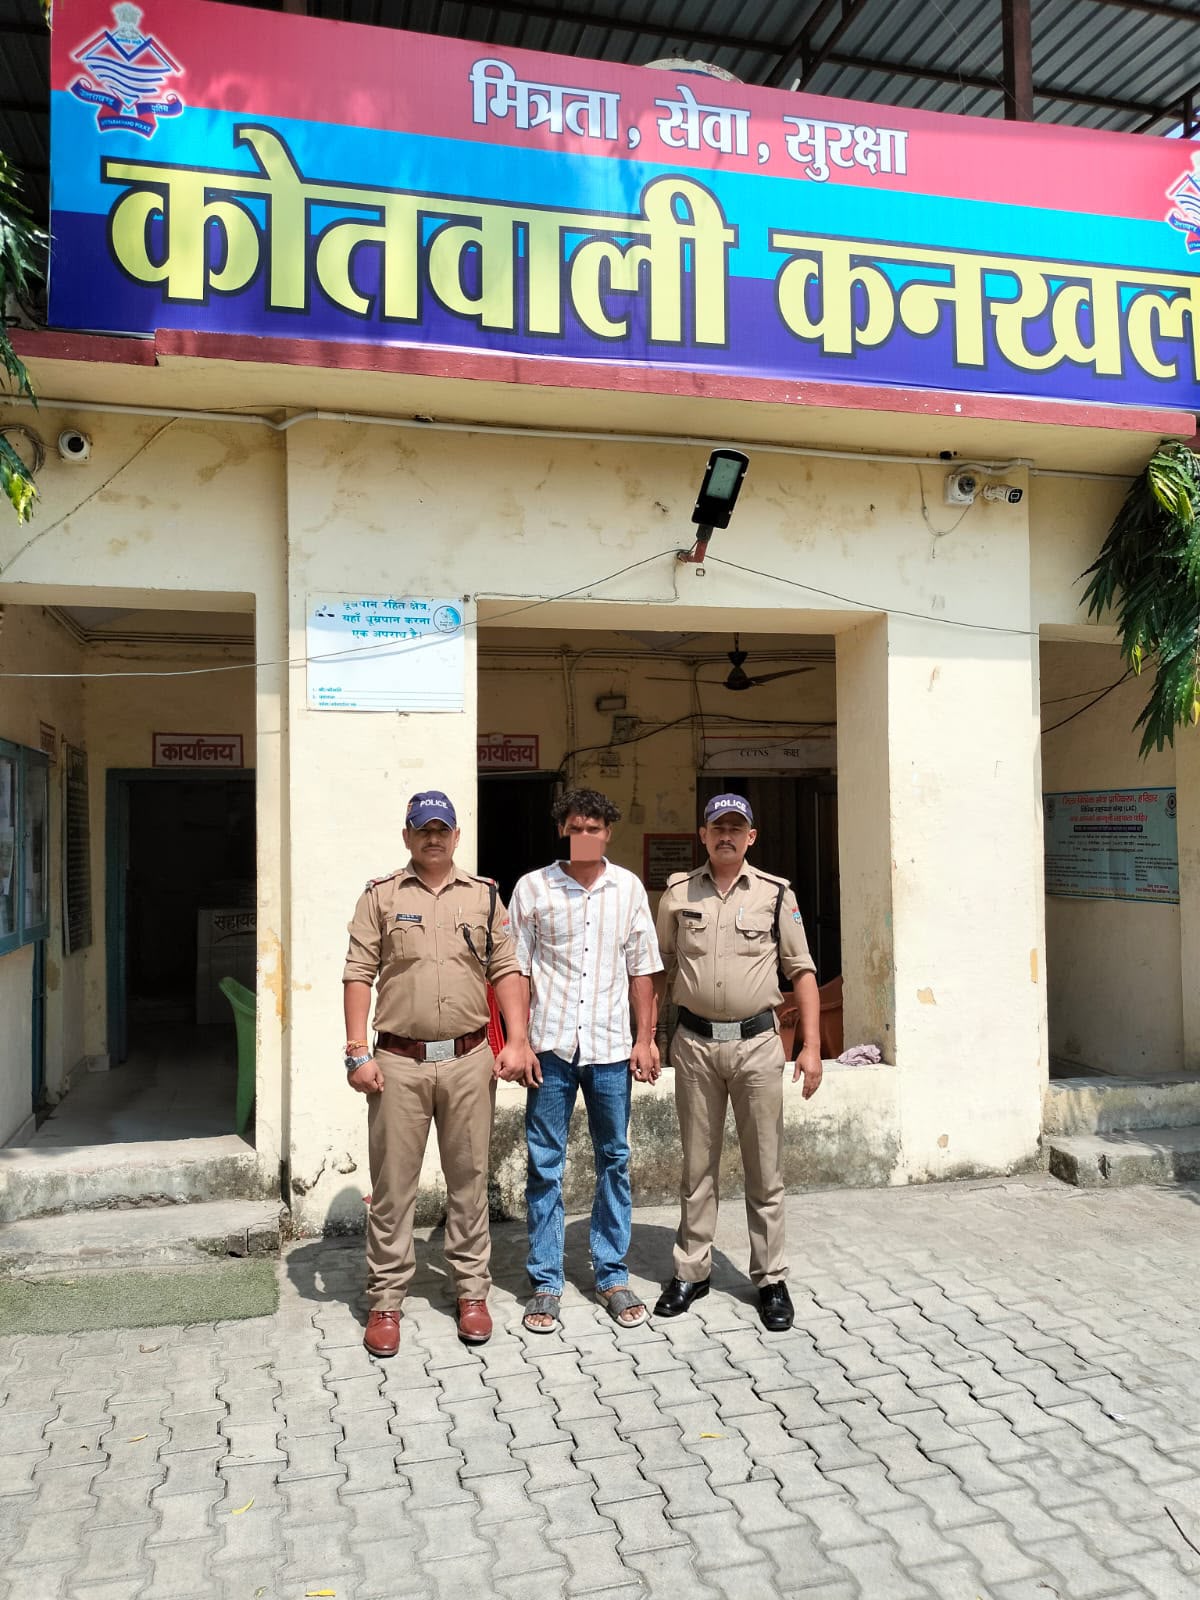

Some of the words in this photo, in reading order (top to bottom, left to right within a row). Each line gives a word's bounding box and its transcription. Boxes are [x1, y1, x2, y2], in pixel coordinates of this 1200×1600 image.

[469, 57, 641, 149] मित्रता,
[655, 86, 770, 164] सेवा,
[784, 115, 908, 182] सुरक्षा
[135, 121, 151, 132] POLICE
[101, 123, 739, 349] कोतवाली
[769, 228, 1200, 382] कनखल
[382, 599, 406, 611] रहित
[404, 616, 431, 625] करना
[352, 629, 369, 639] एक
[373, 629, 407, 639] अपराध
[160, 738, 236, 761] कार्यालय
[419, 799, 449, 809] POLICE
[714, 799, 747, 812] POLICE
